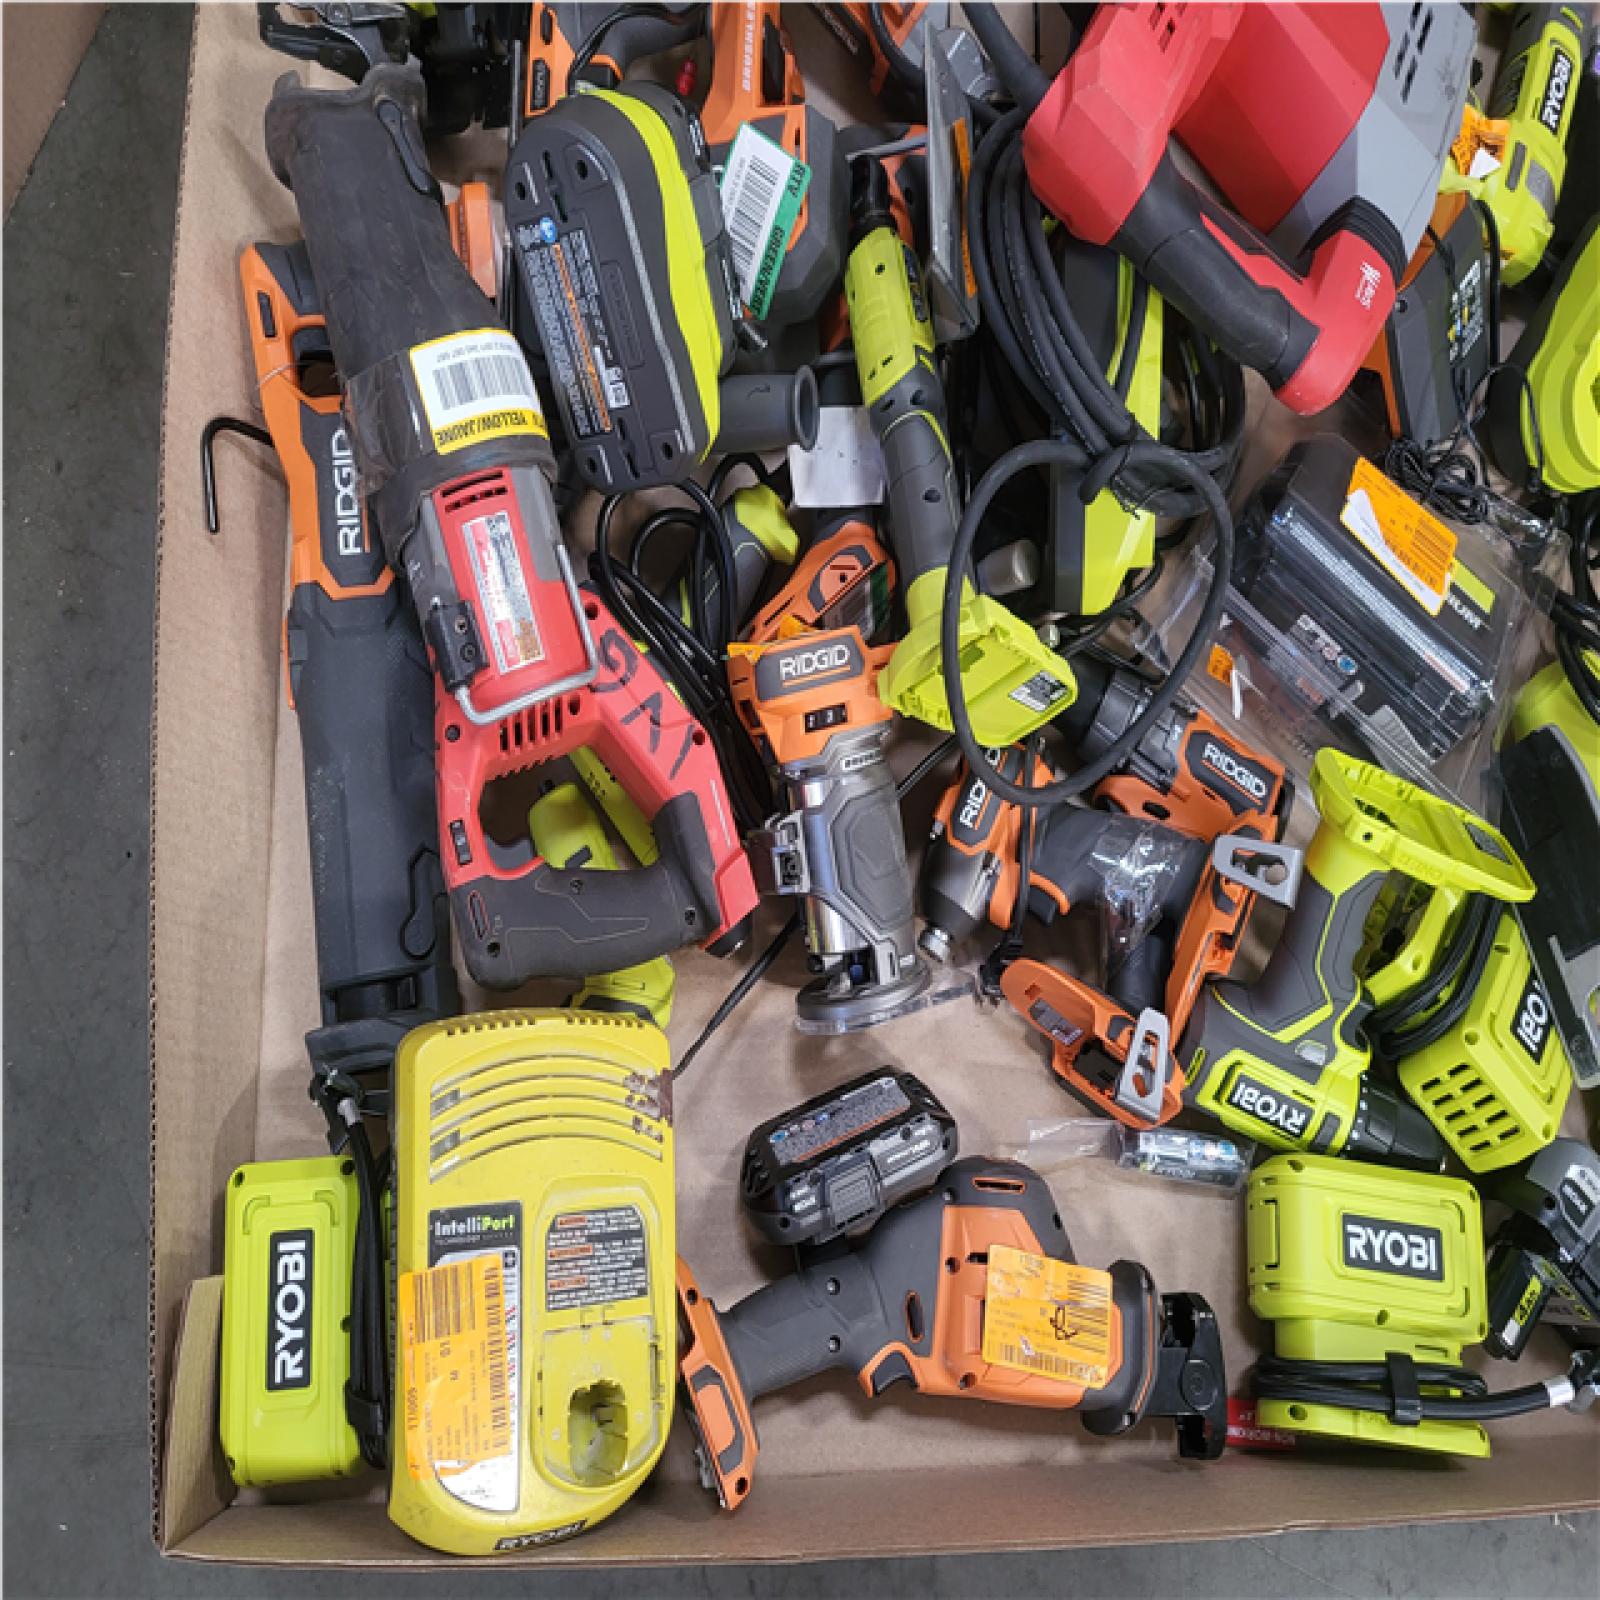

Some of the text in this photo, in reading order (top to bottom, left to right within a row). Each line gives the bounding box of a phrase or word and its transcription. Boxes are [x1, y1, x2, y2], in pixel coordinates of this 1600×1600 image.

[1542, 54, 1570, 128] RYOBI
[331, 429, 361, 556] RIDGID
[779, 644, 851, 681] RIDGID
[959, 747, 1001, 829] RIDD
[1202, 742, 1267, 798] RIDGID
[1516, 980, 1548, 1053] OBI
[1231, 1082, 1306, 1134] RYOBI
[1346, 1224, 1437, 1271] RYOBI
[274, 1240, 306, 1384] RYOBI
